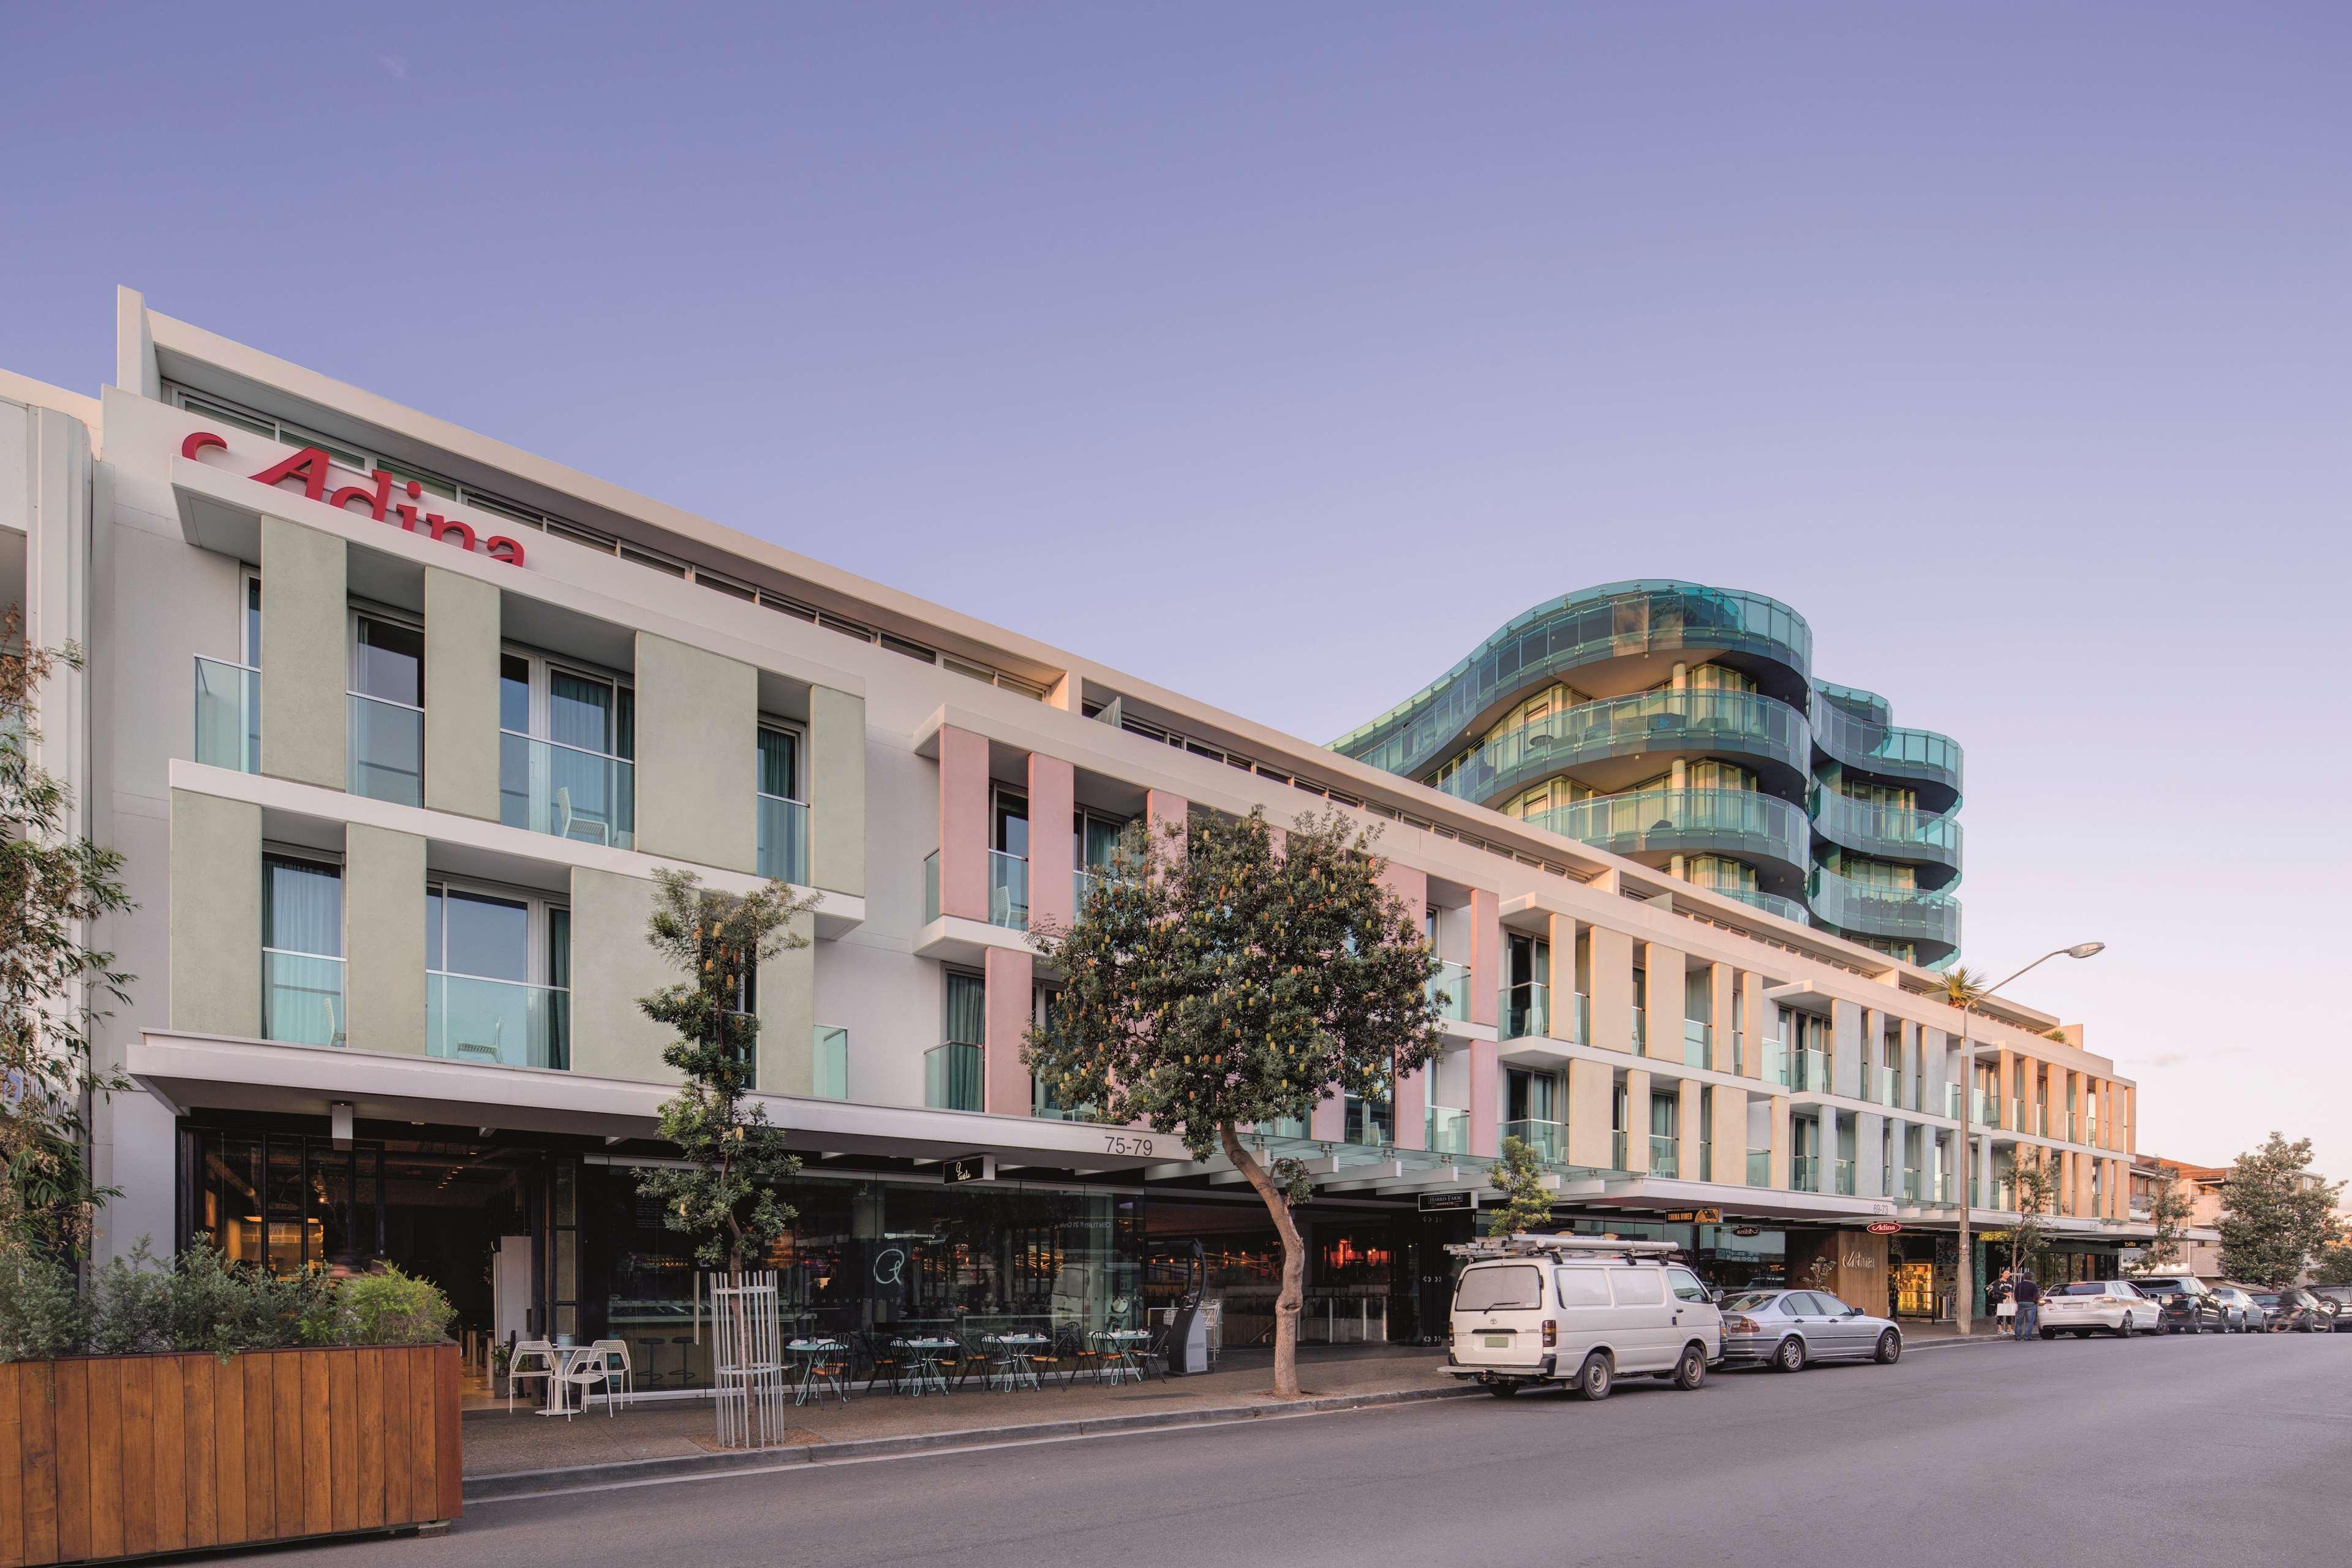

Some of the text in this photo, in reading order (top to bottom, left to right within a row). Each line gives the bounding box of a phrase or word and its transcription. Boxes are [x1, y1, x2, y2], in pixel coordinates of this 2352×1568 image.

[182, 432, 524, 568] Adina
[1105, 1136, 1152, 1156] 75-79
[1873, 1204, 1888, 1214] 69-73
